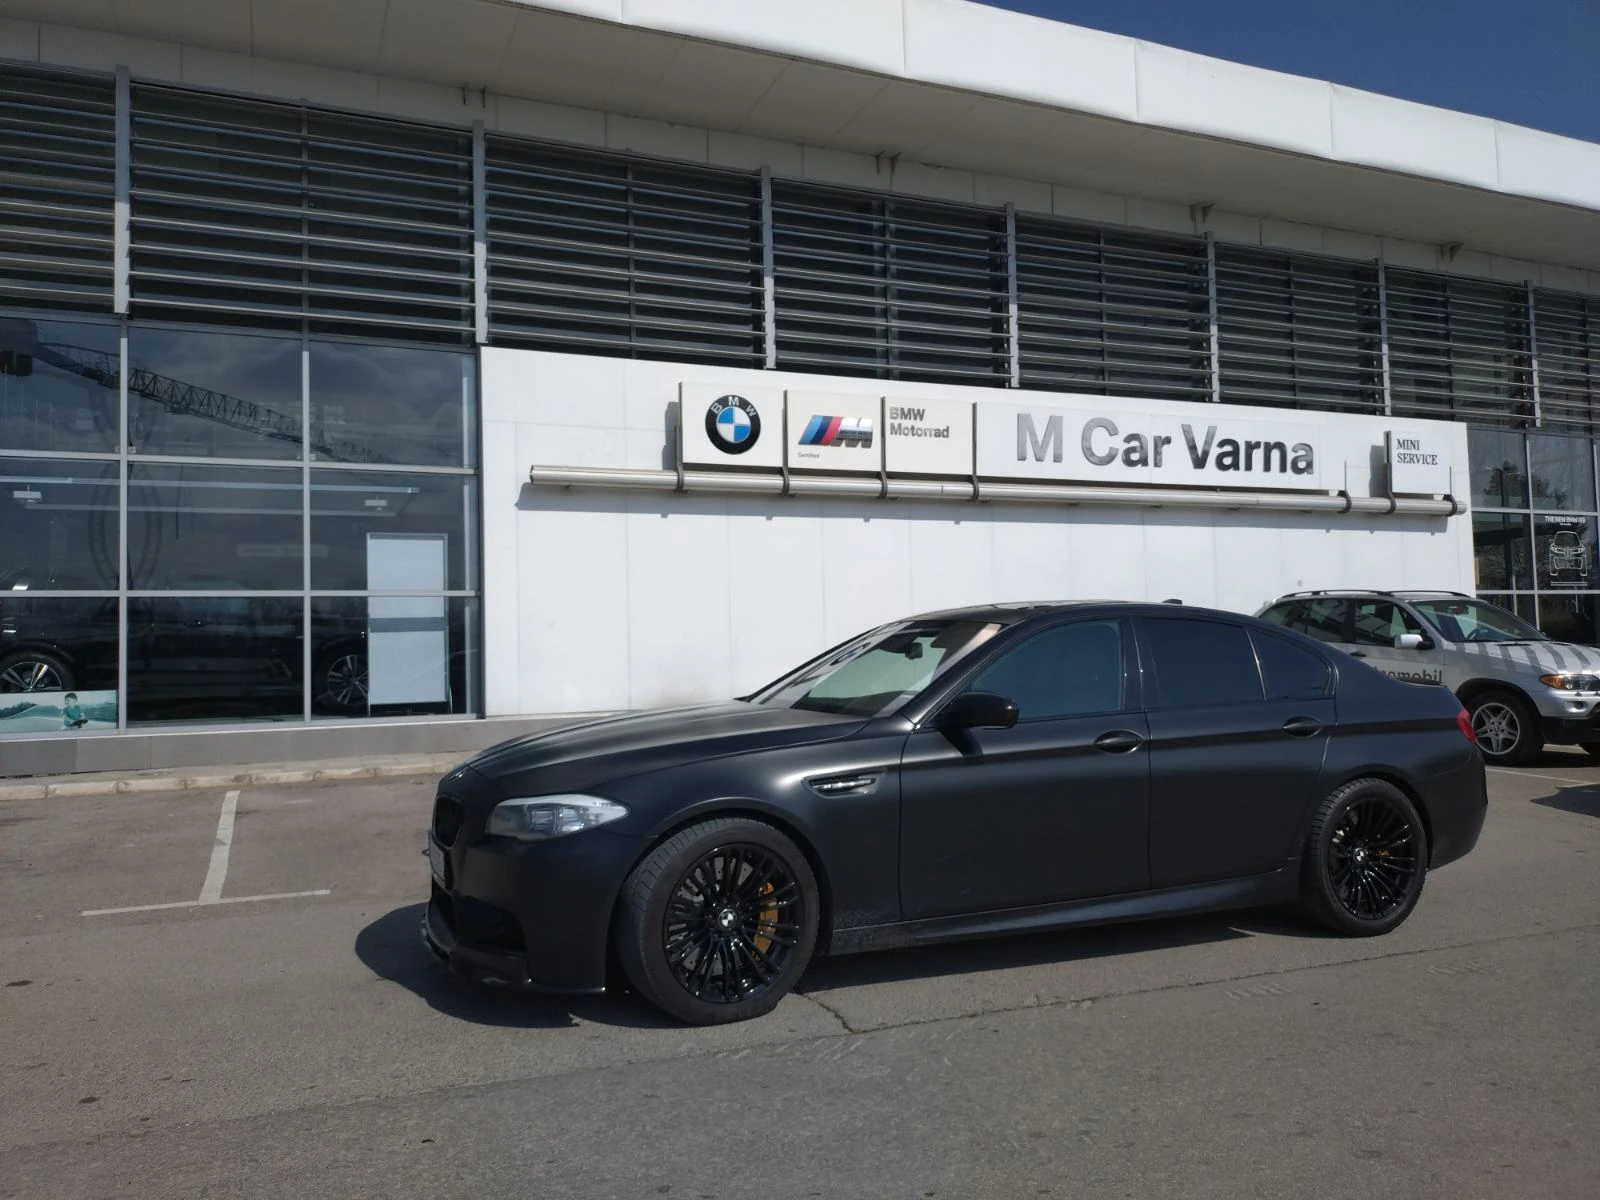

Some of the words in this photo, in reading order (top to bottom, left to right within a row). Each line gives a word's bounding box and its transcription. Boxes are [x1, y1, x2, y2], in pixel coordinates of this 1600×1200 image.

[710, 396, 757, 417] BMW
[890, 406, 926, 421] BMW
[890, 422, 950, 438] Motorrad
[1016, 413, 1063, 462] M
[1081, 417, 1172, 468] Car
[1181, 424, 1314, 475] Varna
[1396, 439, 1421, 450] MINI
[1397, 453, 1438, 465] SERVICE
